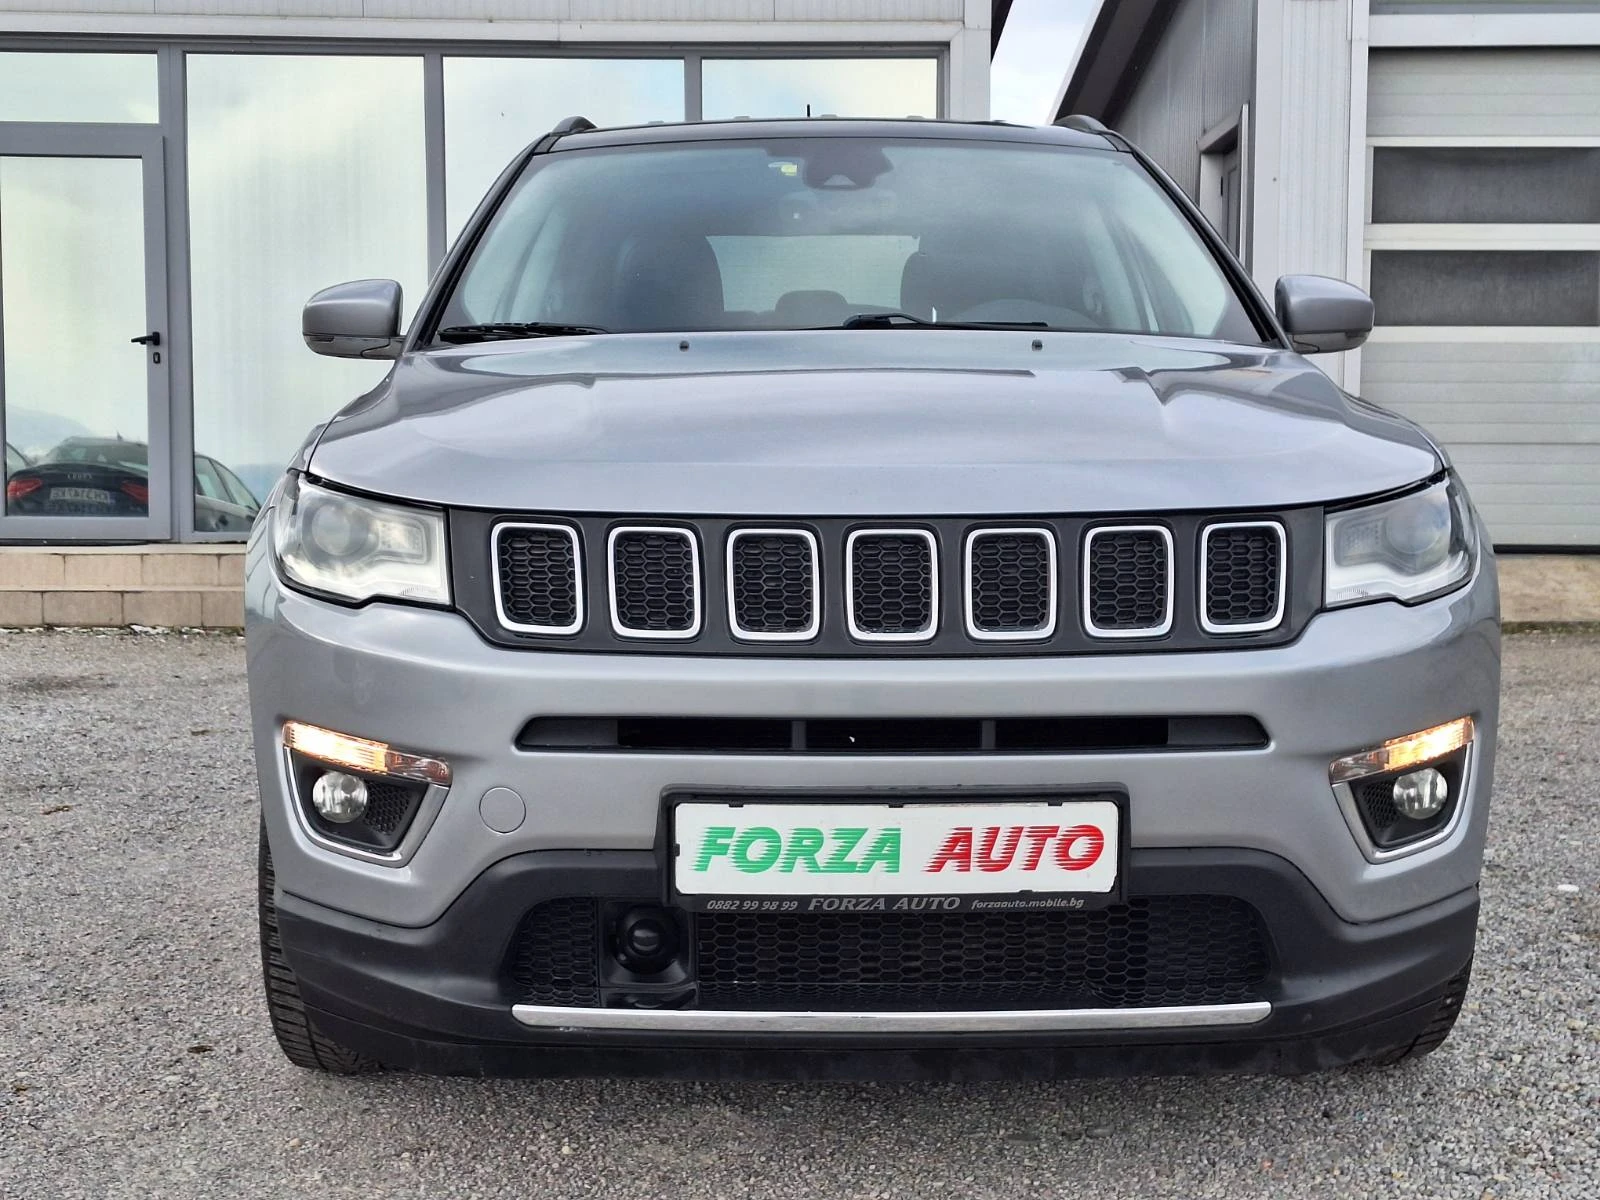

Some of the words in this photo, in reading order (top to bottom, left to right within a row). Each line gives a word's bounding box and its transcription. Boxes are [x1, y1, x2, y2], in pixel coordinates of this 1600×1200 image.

[691, 826, 901, 874] FORZA
[921, 824, 1105, 873] AUTO
[706, 900, 739, 910] 0882
[742, 900, 759, 910] 99
[761, 901, 778, 911] 98
[780, 901, 798, 911] 99
[807, 898, 886, 911] FORZA
[892, 897, 961, 910] AUTO
[971, 898, 1085, 910] forzaauto.mobile.bg
